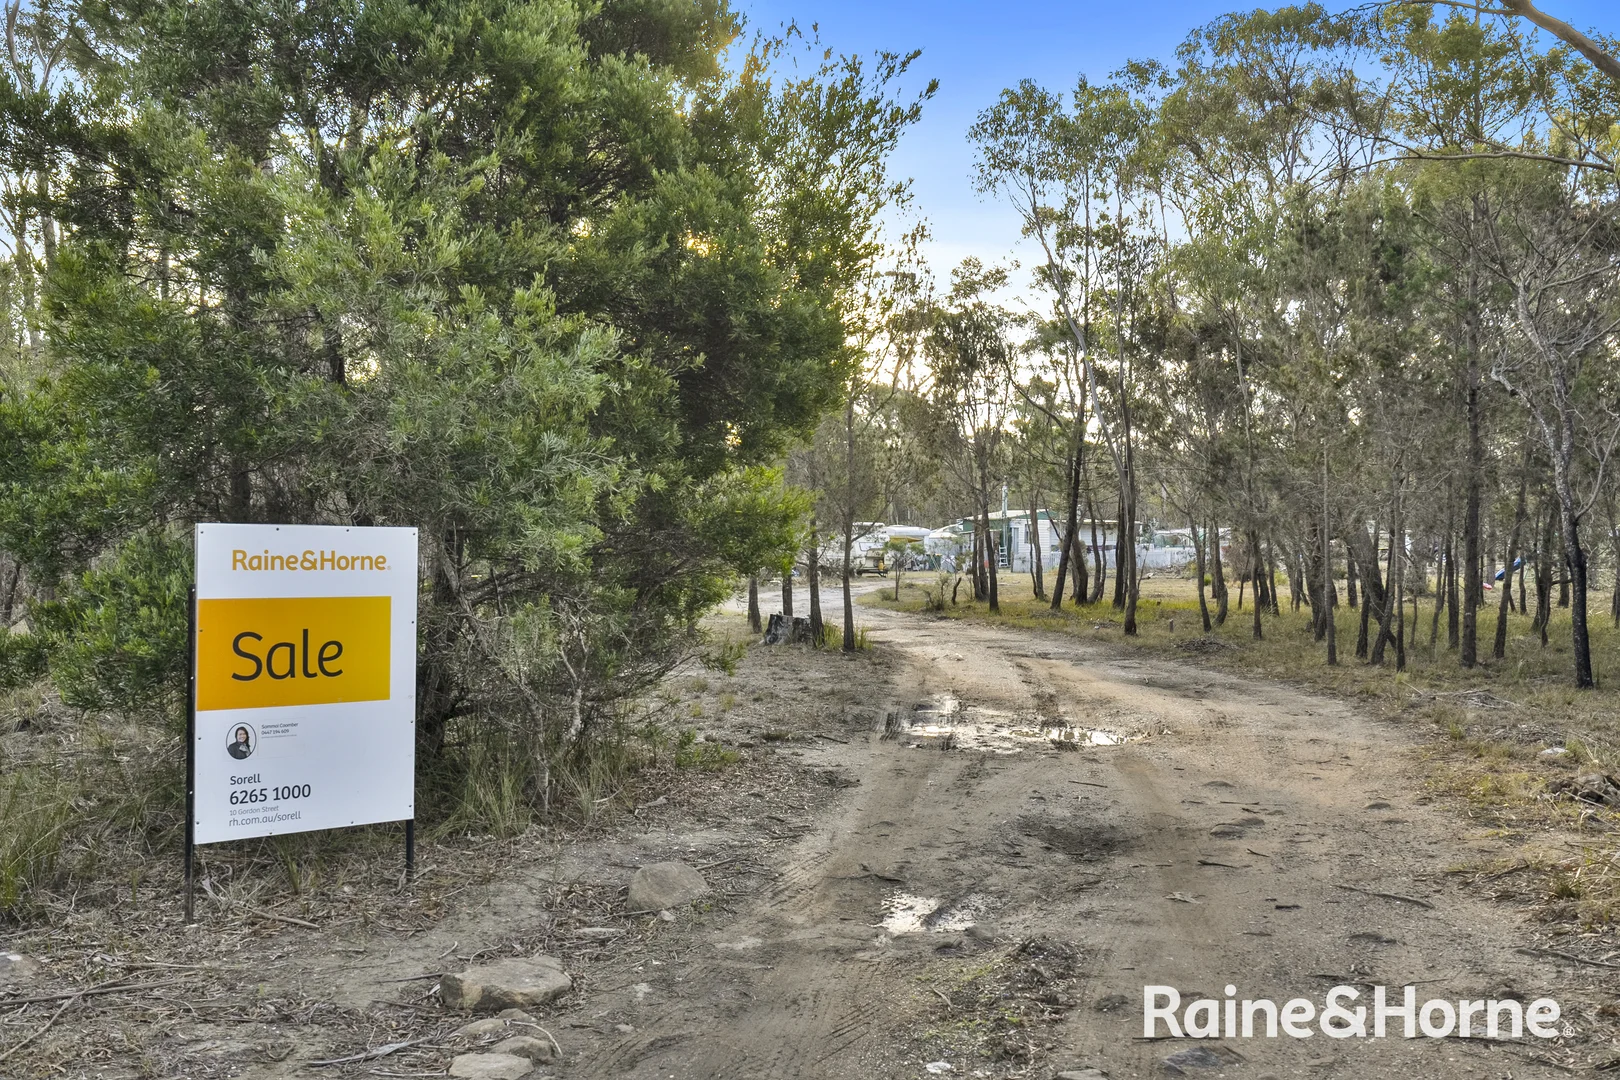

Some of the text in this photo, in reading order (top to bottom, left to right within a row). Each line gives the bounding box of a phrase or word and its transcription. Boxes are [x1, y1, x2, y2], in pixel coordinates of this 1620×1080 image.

[231, 629, 344, 682] Sale
[230, 774, 261, 785] Sorell
[230, 784, 311, 805] 6265 1000
[229, 811, 301, 827] rh.com.au/sorell
